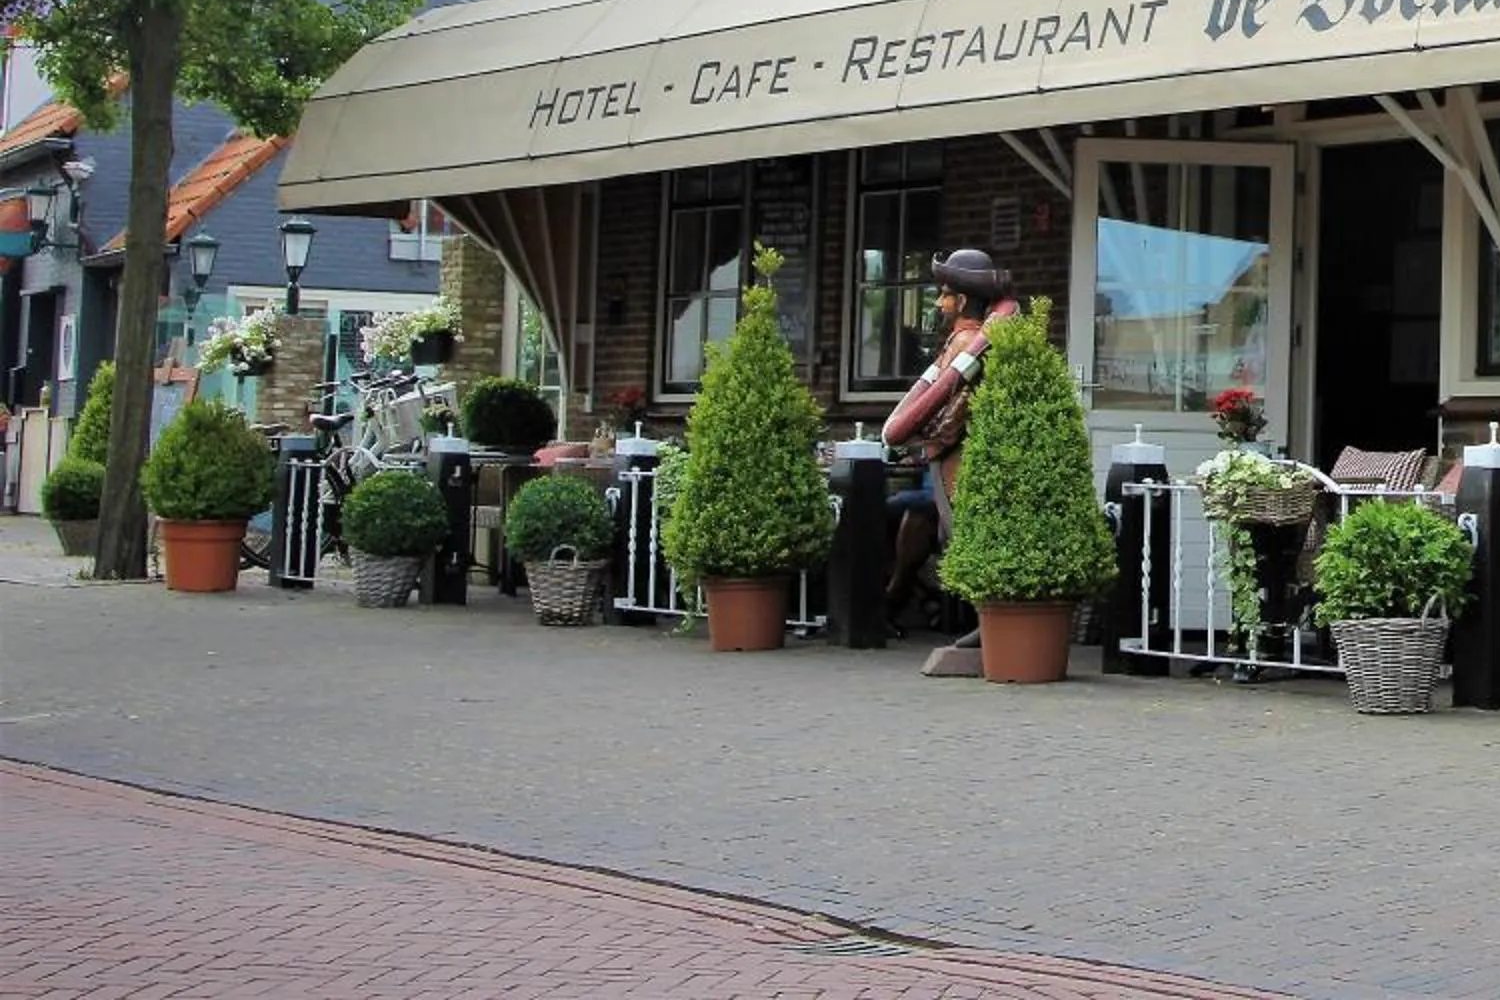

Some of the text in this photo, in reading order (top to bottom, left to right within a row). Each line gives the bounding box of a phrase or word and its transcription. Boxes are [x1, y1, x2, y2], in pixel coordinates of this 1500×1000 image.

[529, 81, 641, 129] HOTEL
[690, 56, 797, 105] CAFE
[842, 0, 1169, 83] RESTAURANT
